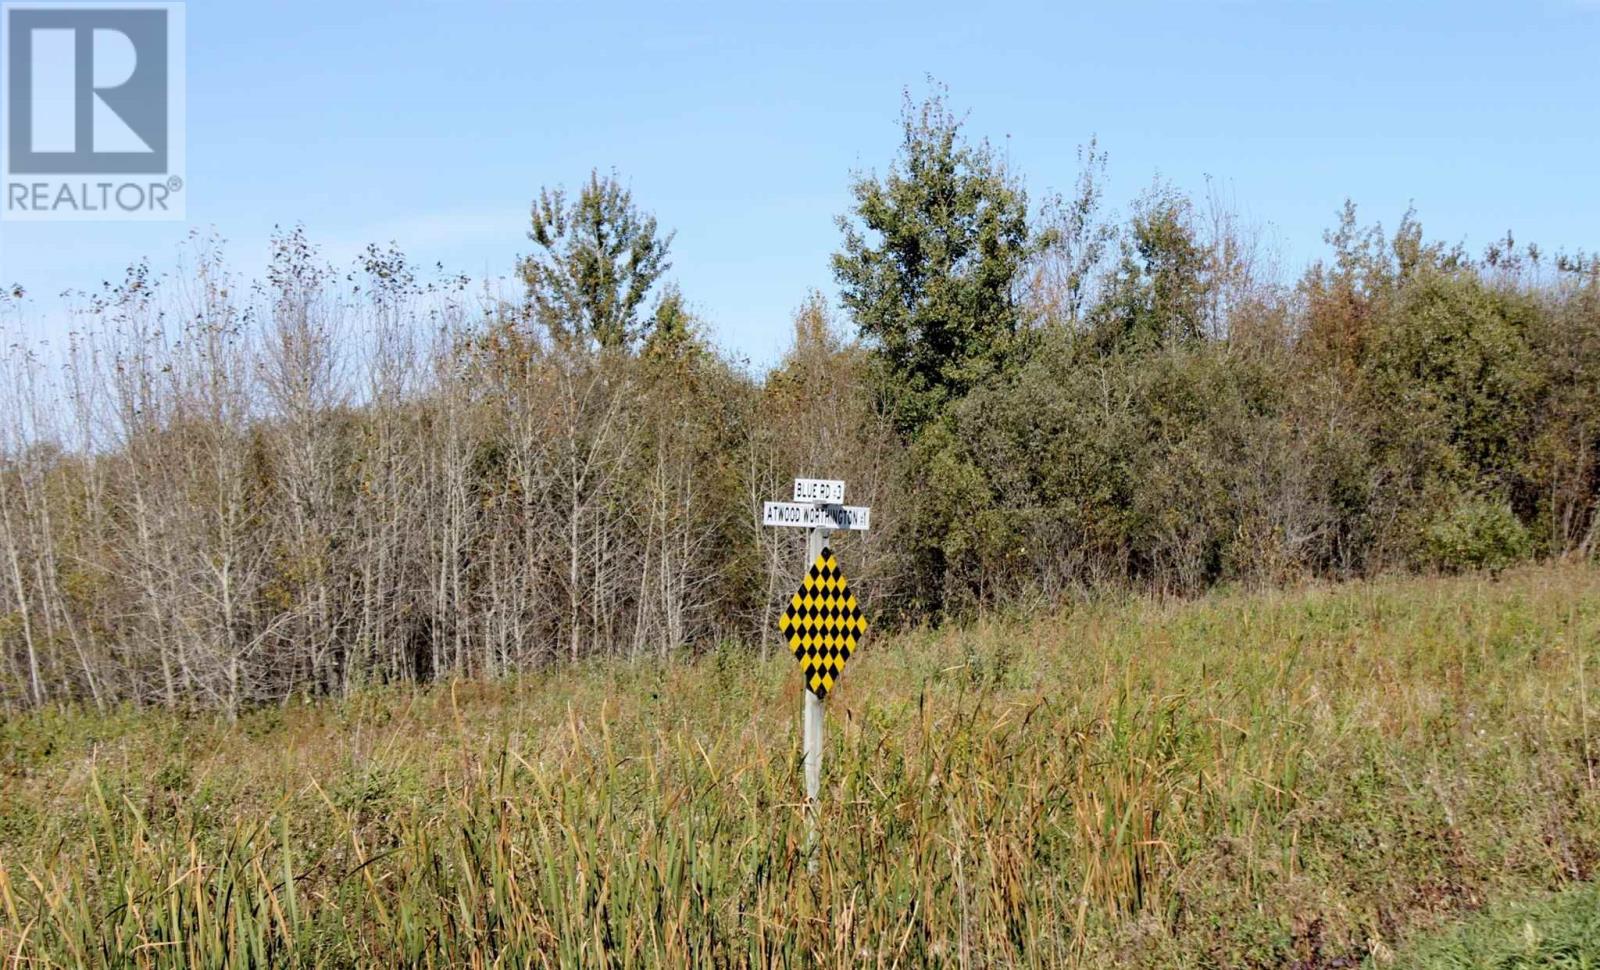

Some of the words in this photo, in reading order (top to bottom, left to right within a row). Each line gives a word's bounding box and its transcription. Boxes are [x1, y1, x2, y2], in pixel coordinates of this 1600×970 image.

[797, 482, 817, 498] BLUE
[820, 484, 830, 499] RD
[767, 506, 800, 522] ATWOOD
[803, 507, 858, 525] WORTHINGTON
